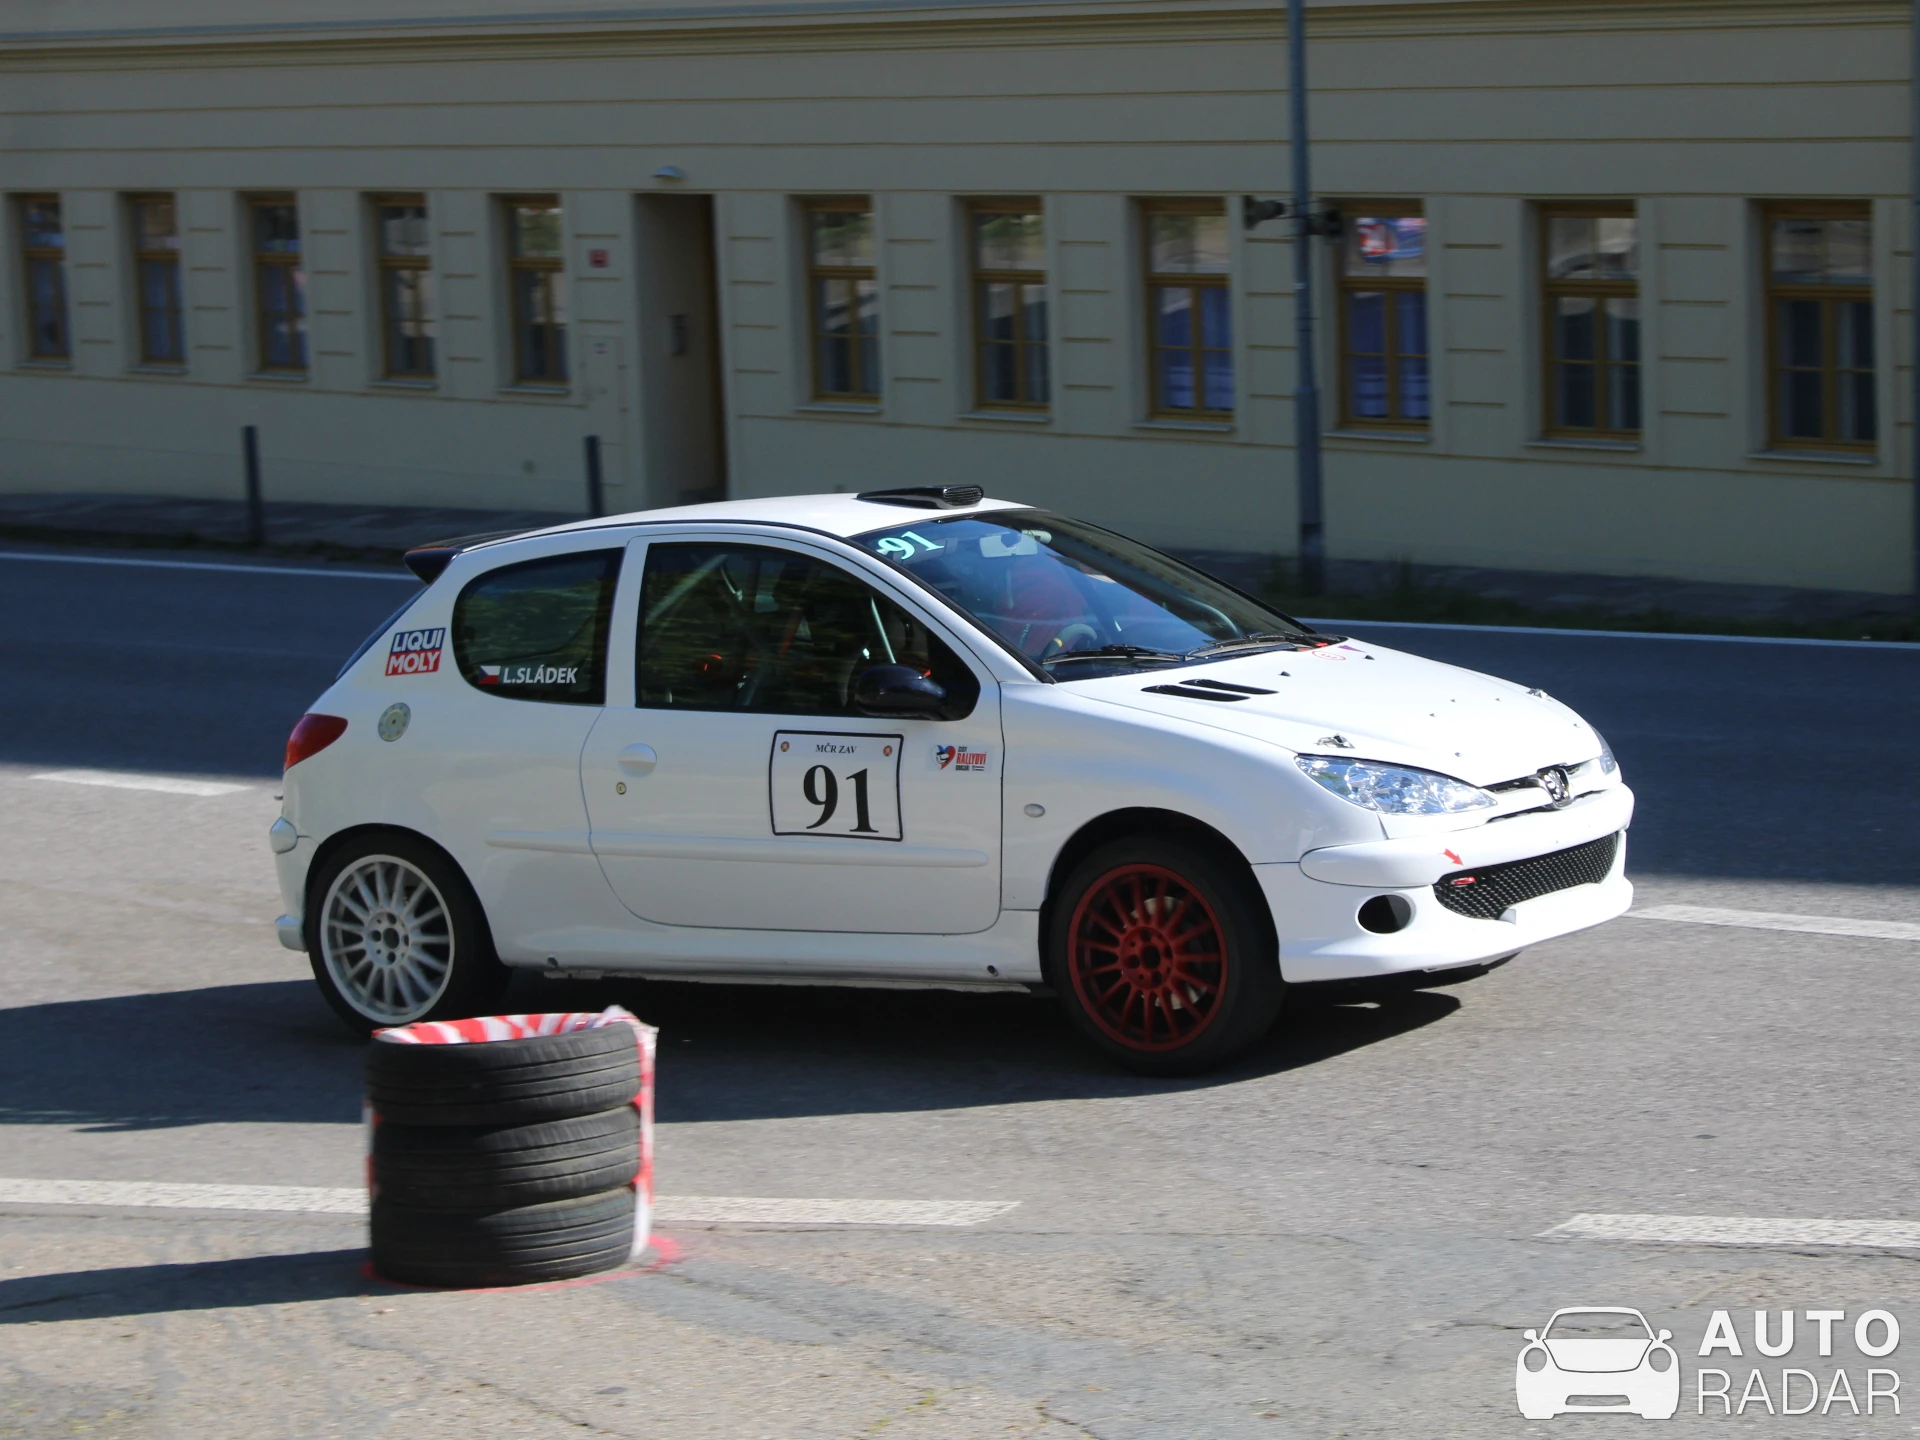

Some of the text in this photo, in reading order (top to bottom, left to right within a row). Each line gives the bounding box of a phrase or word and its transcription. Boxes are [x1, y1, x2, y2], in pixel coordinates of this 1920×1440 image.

[877, 530, 945, 560] 91
[392, 629, 444, 653] LIQUI
[387, 651, 441, 675] MOLY
[503, 664, 578, 684] L.SLÁDEK
[815, 742, 857, 754] MČR ZAV
[803, 764, 879, 833] 91
